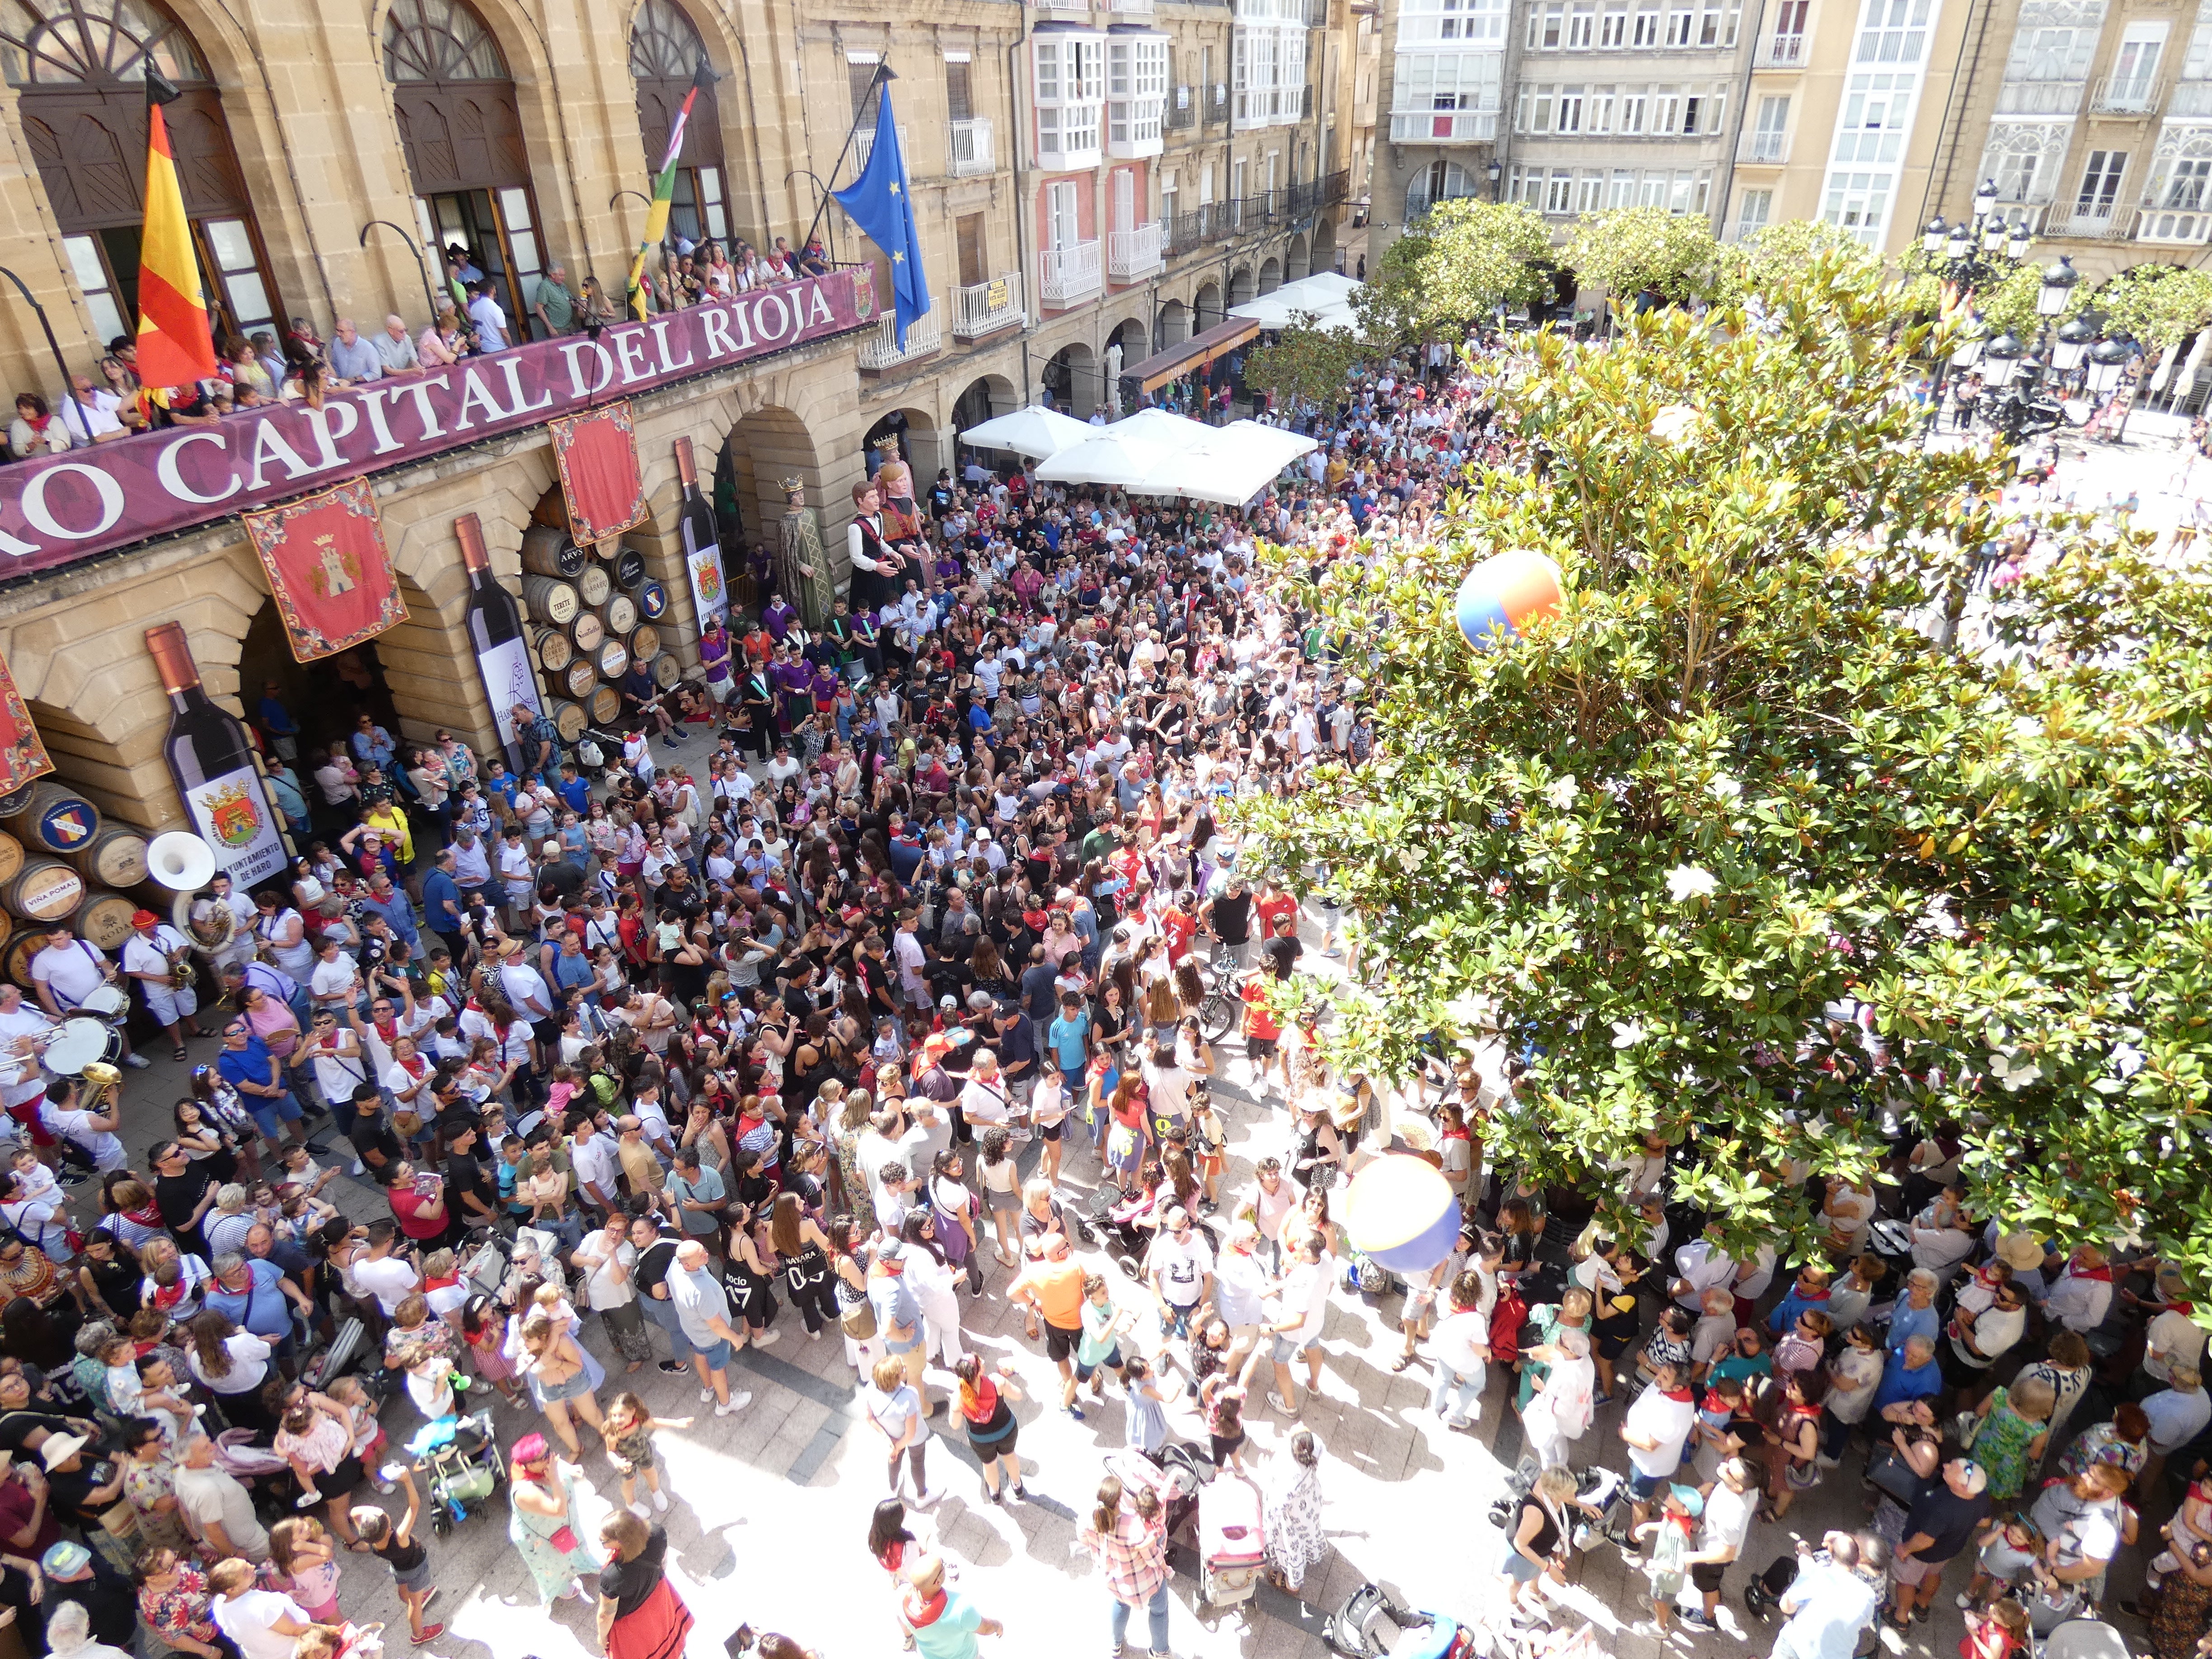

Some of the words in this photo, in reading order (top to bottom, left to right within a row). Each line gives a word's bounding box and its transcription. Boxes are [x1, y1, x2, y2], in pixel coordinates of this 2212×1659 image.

[1227, 334, 1243, 349] TORMO
[1166, 363, 1187, 381] TORMO
[157, 356, 553, 505] CAPITAL
[559, 319, 694, 399] DEL
[698, 284, 834, 360] RIOJA
[553, 599, 571, 611] TERETE
[612, 653, 625, 661] POMAL
[223, 842, 280, 873] AYUNTAMIENTO
[240, 870, 250, 882] DE
[251, 860, 272, 876] HARO
[28, 895, 48, 906] VIÑA
[49, 881, 77, 897] POMAL
[99, 924, 131, 942] RODA
[1155, 1119, 1172, 1138] 9
[786, 1251, 816, 1265] NAYARA
[726, 1273, 747, 1286] ROCÍO
[725, 1284, 752, 1310] 17
